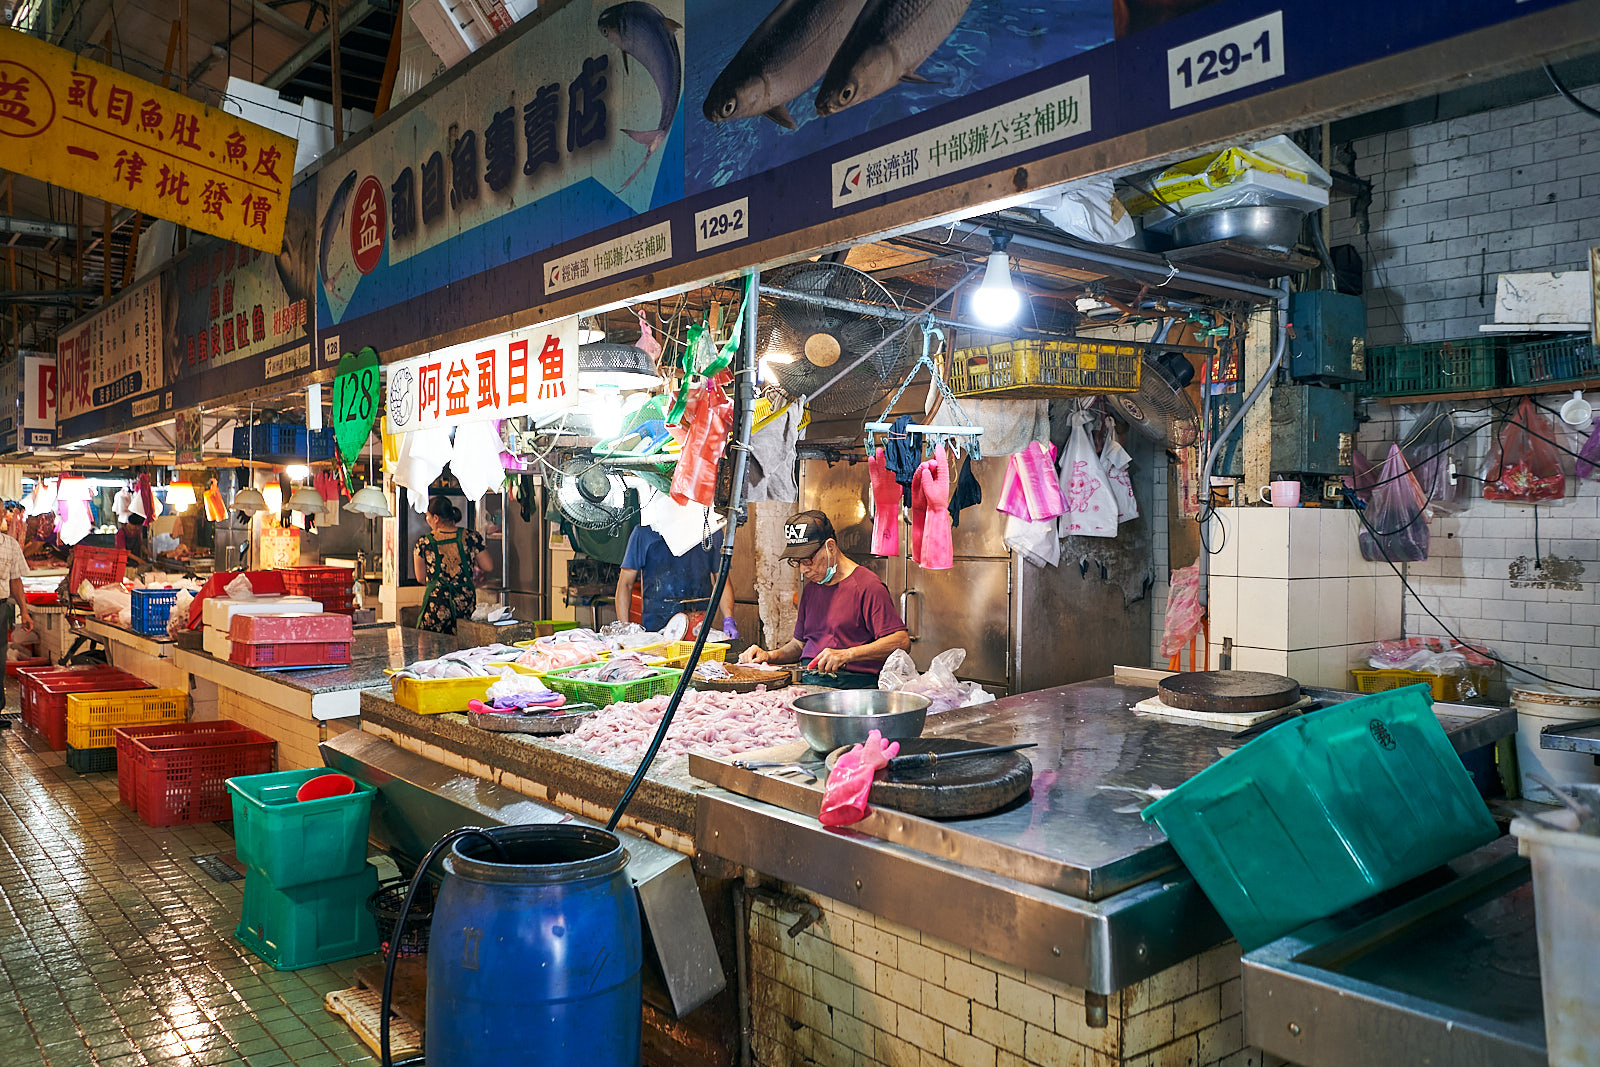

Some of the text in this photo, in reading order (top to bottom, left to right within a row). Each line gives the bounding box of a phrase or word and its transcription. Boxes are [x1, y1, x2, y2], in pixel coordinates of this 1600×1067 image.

[1176, 30, 1272, 89] 129-1
[0, 71, 37, 127] 益
[390, 54, 610, 242] 虱目魚專賣店
[864, 95, 1080, 188] 經濟部 中部辦公室補助
[66, 145, 273, 235] 一律批發價
[357, 187, 382, 256] 益
[699, 208, 744, 239] 129-2
[561, 233, 667, 284] 經濟部 中部辦公室補助
[326, 341, 338, 355] 128
[338, 368, 374, 424] 128
[418, 334, 567, 422] 阿益虱目魚
[784, 523, 808, 540] EA7
